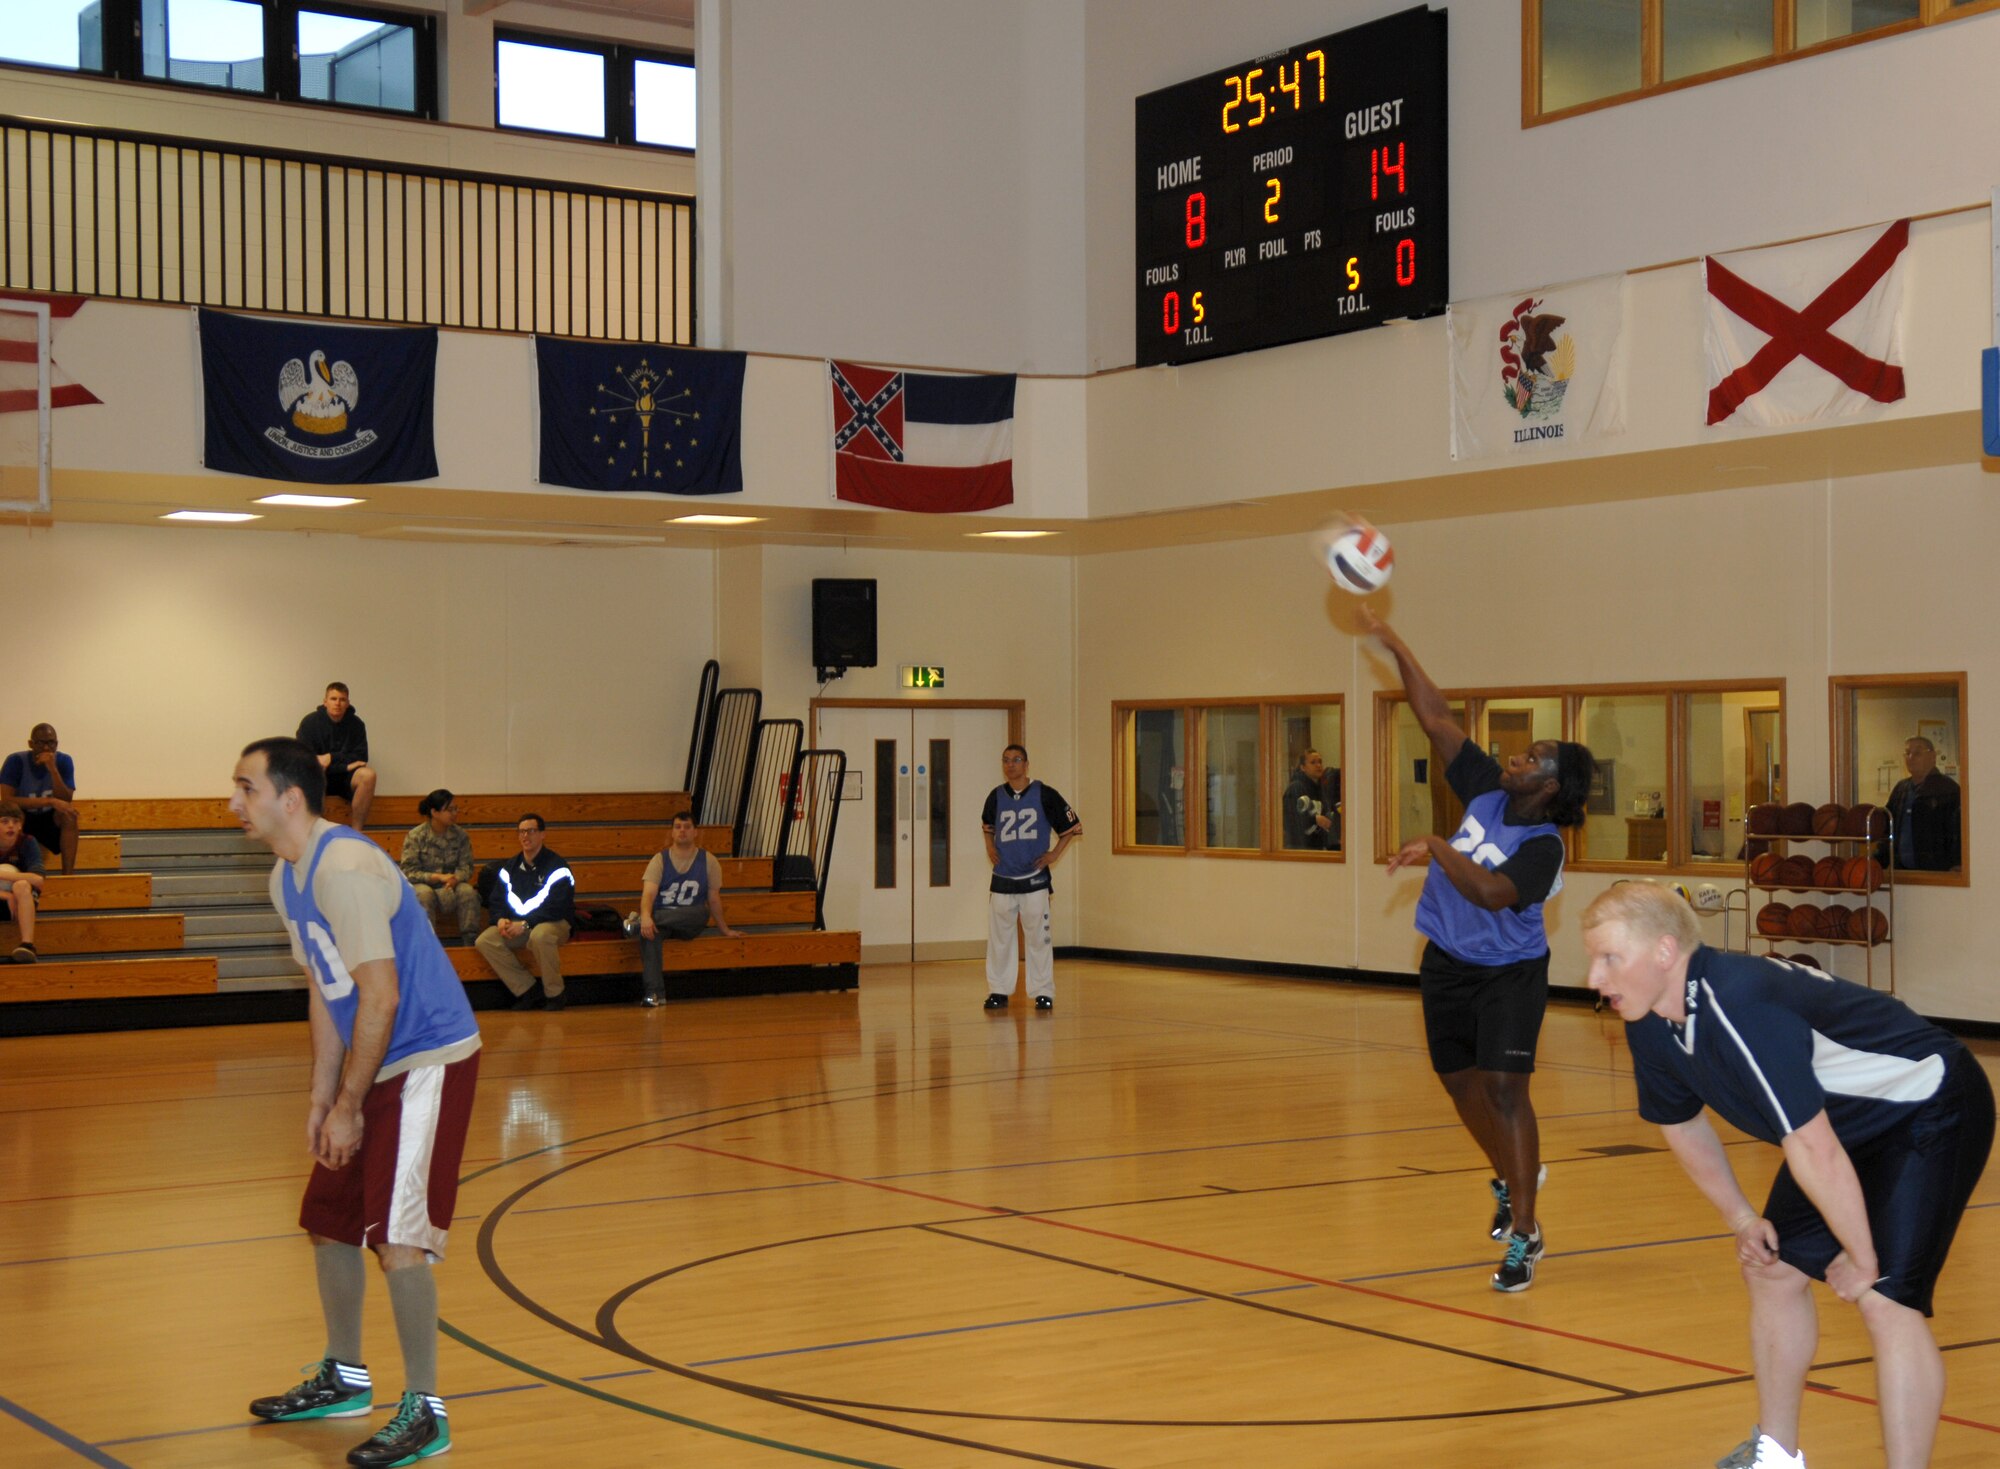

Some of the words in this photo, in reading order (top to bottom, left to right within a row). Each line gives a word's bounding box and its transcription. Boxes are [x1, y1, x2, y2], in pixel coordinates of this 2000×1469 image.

[1222, 50, 1325, 133] 25:47
[1345, 99, 1403, 139] GUEST
[1158, 156, 1201, 190] HOME
[1253, 146, 1293, 172] PERIOD
[1371, 142, 1405, 200] 14
[1264, 178, 1281, 224] 2
[1185, 192, 1207, 249] 8
[1376, 207, 1415, 232] FOULS
[1225, 248, 1245, 268] PLYR
[1260, 238, 1287, 259] FOUL
[1305, 230, 1321, 250] PTS
[1396, 238, 1415, 286] 0
[1147, 264, 1178, 285] FOULS
[1163, 291, 1180, 335] 0
[1338, 293, 1369, 315] T.O.L.
[1185, 326, 1212, 345] T.O.L.
[629, 367, 659, 382] INDIANA
[290, 442, 318, 457] JUSTICE
[319, 448, 334, 457] AND
[334, 433, 375, 456] CONFIDENCE
[1514, 424, 1564, 443] ILLINOIS
[1000, 808, 1038, 843] 22
[660, 880, 700, 906] 40
